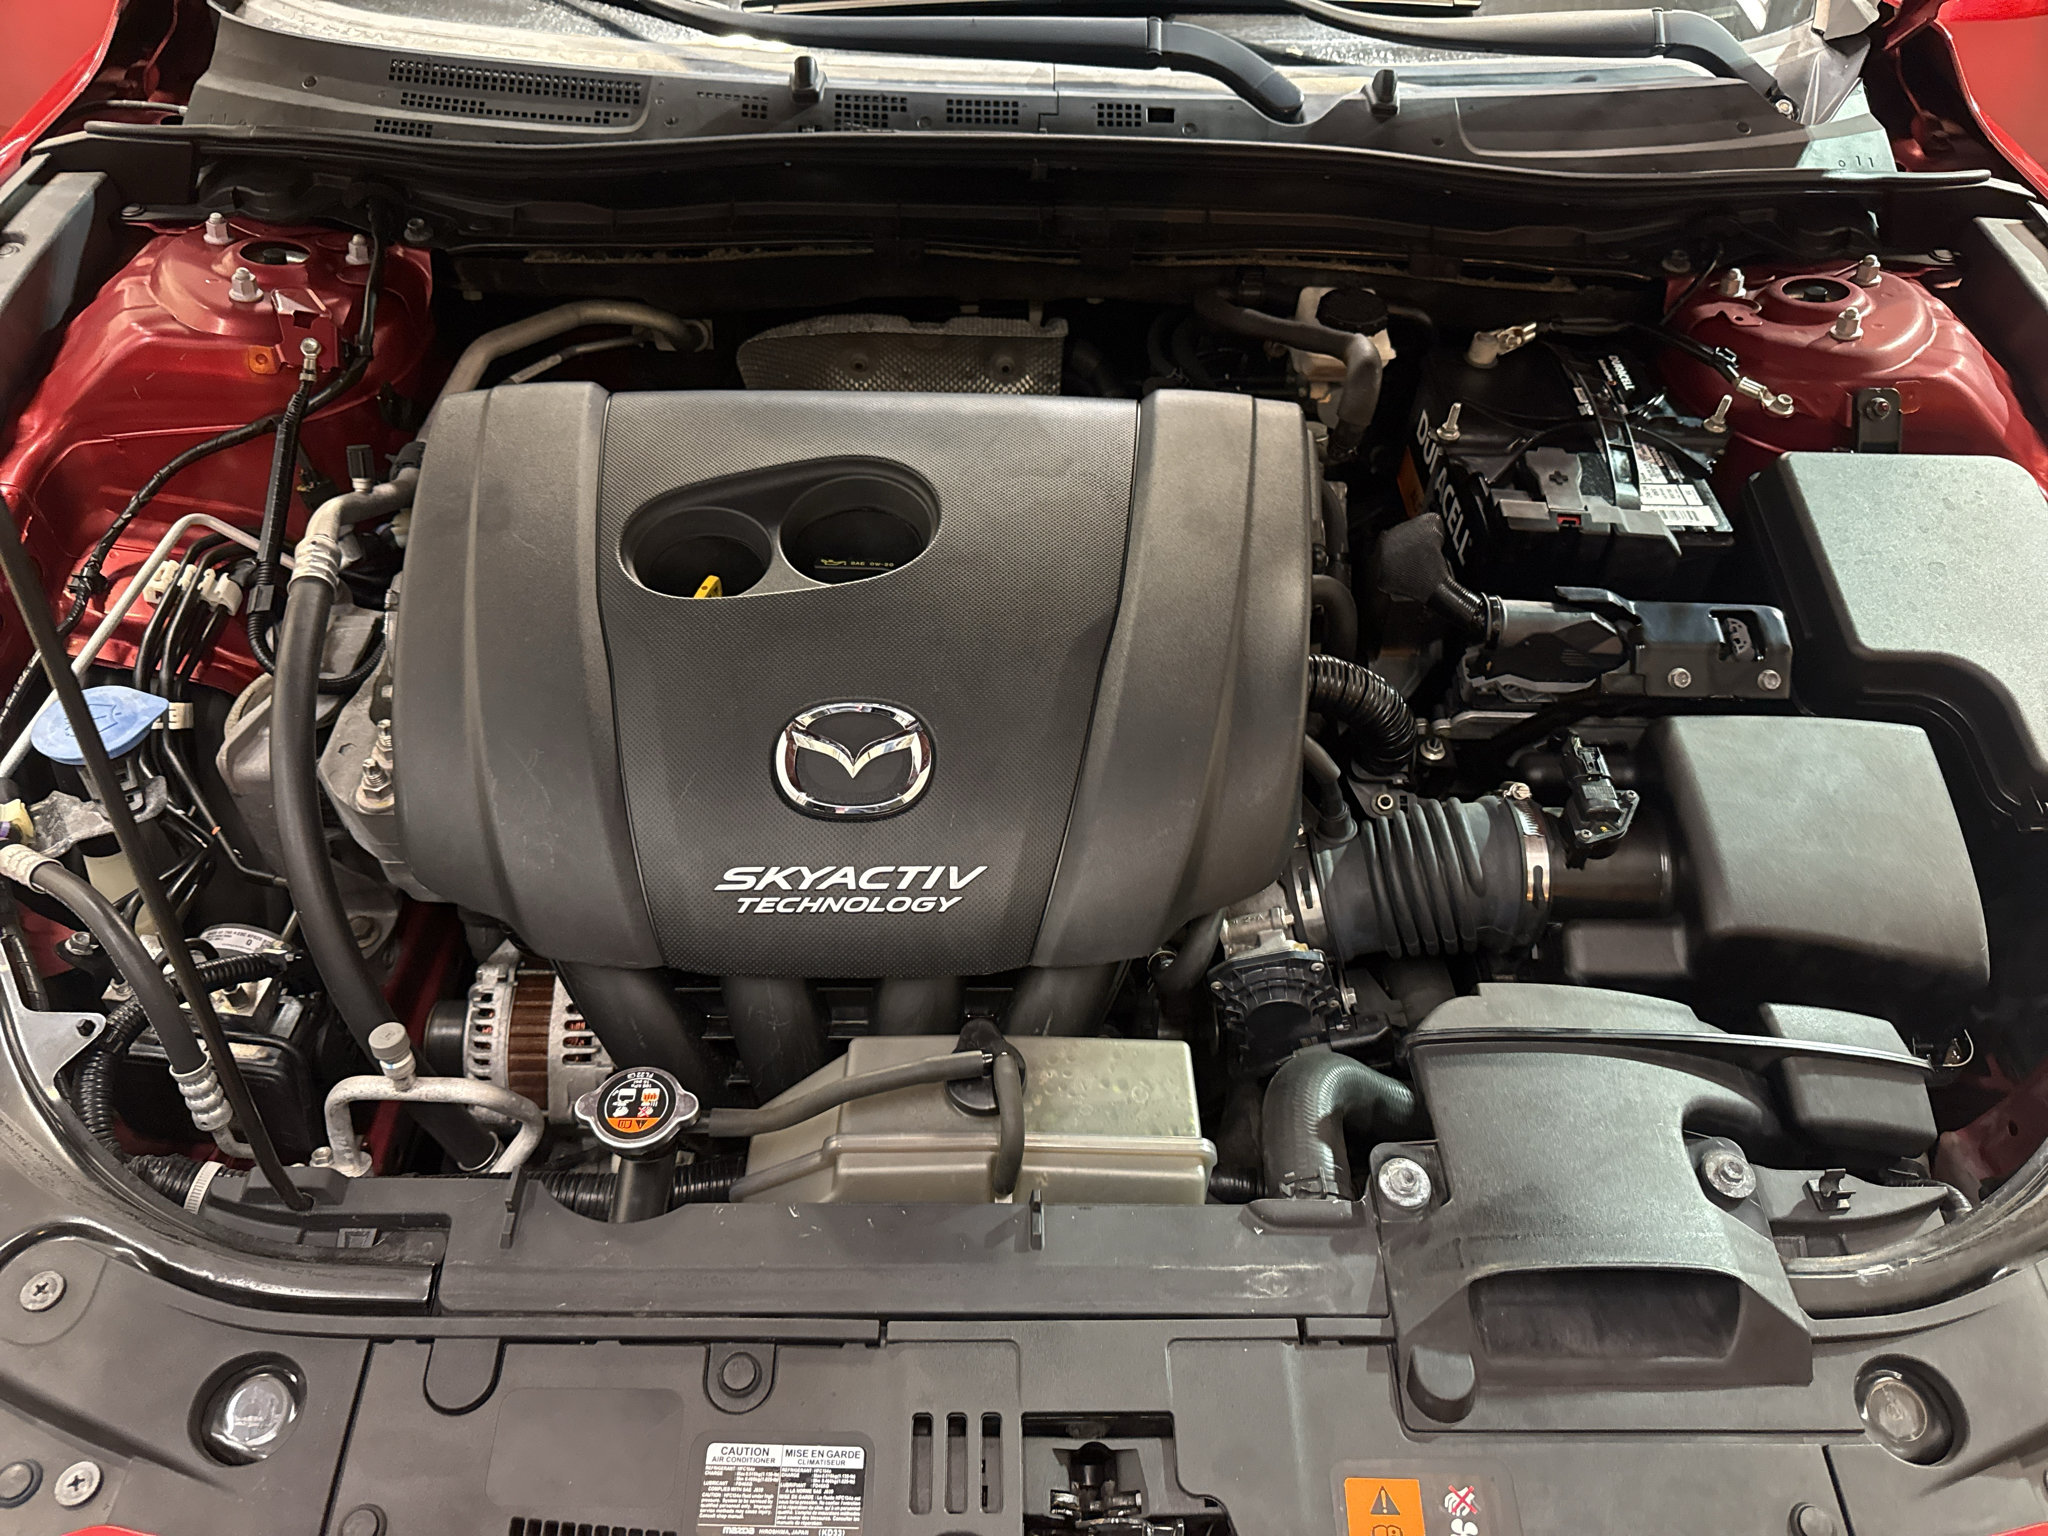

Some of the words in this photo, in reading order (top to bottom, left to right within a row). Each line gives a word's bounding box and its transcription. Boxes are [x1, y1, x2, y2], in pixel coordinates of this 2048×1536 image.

[1608, 355, 1635, 391] DURACELL
[714, 866, 989, 891] SKYACTIV
[737, 896, 963, 914] TECHNOLOGY
[721, 1446, 770, 1456] CAUTION
[785, 1449, 809, 1458] MISE
[811, 1450, 825, 1458] EN
[826, 1450, 861, 1459] GARDE
[726, 1456, 775, 1464] CONDITIONER
[797, 1458, 846, 1466] CLIMATISEUR
[723, 1526, 755, 1535] mazda
